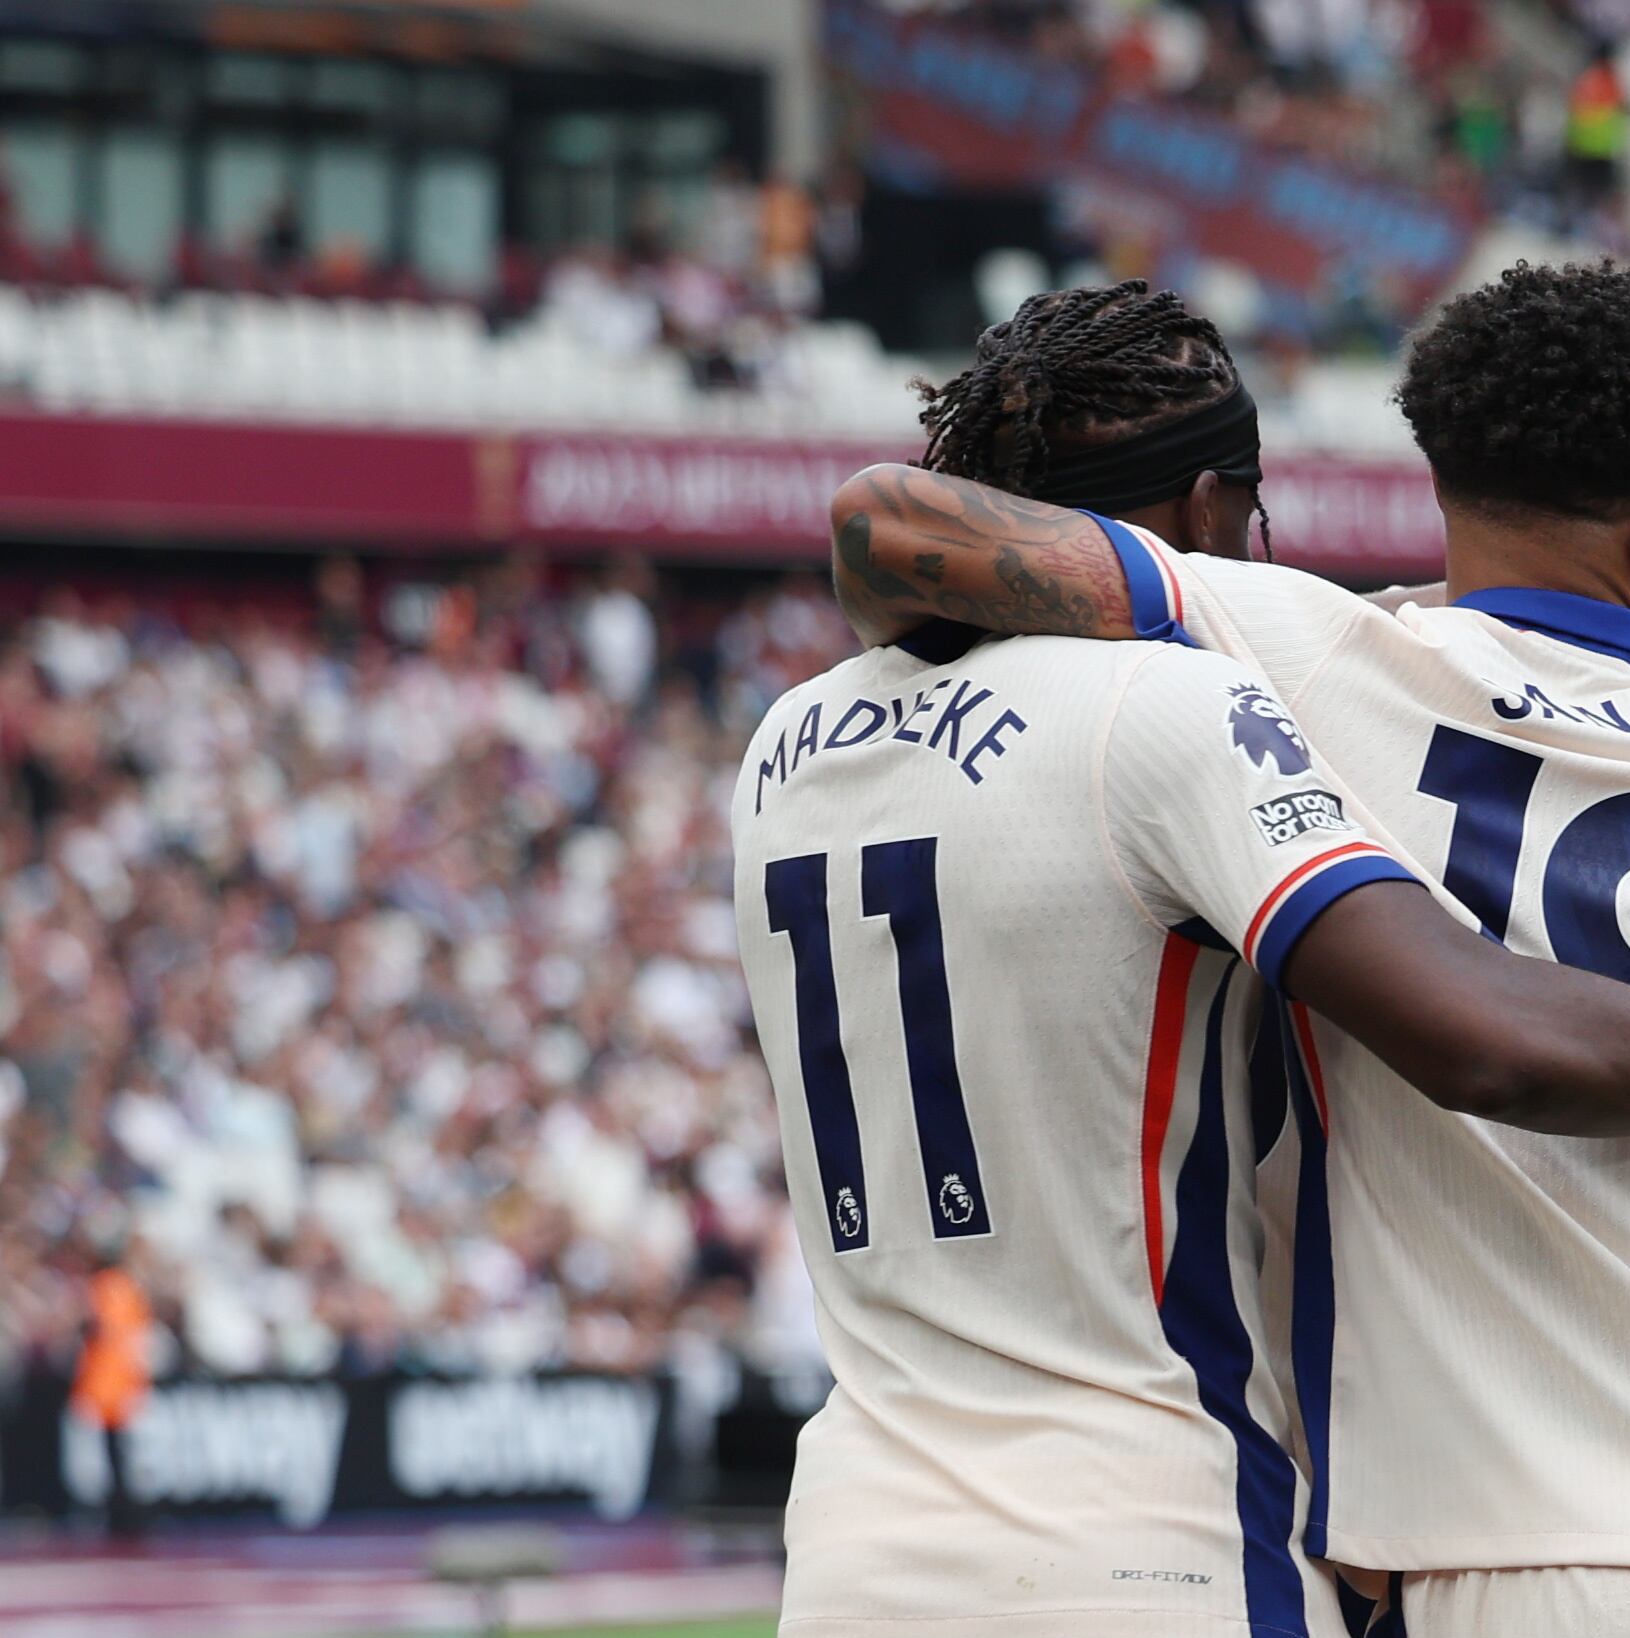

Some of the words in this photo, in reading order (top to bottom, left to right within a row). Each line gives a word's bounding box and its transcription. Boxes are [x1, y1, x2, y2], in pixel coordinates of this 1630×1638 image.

[1250, 802, 1294, 830] No
[1261, 817, 1299, 847] for
[763, 835, 995, 1255] 11
